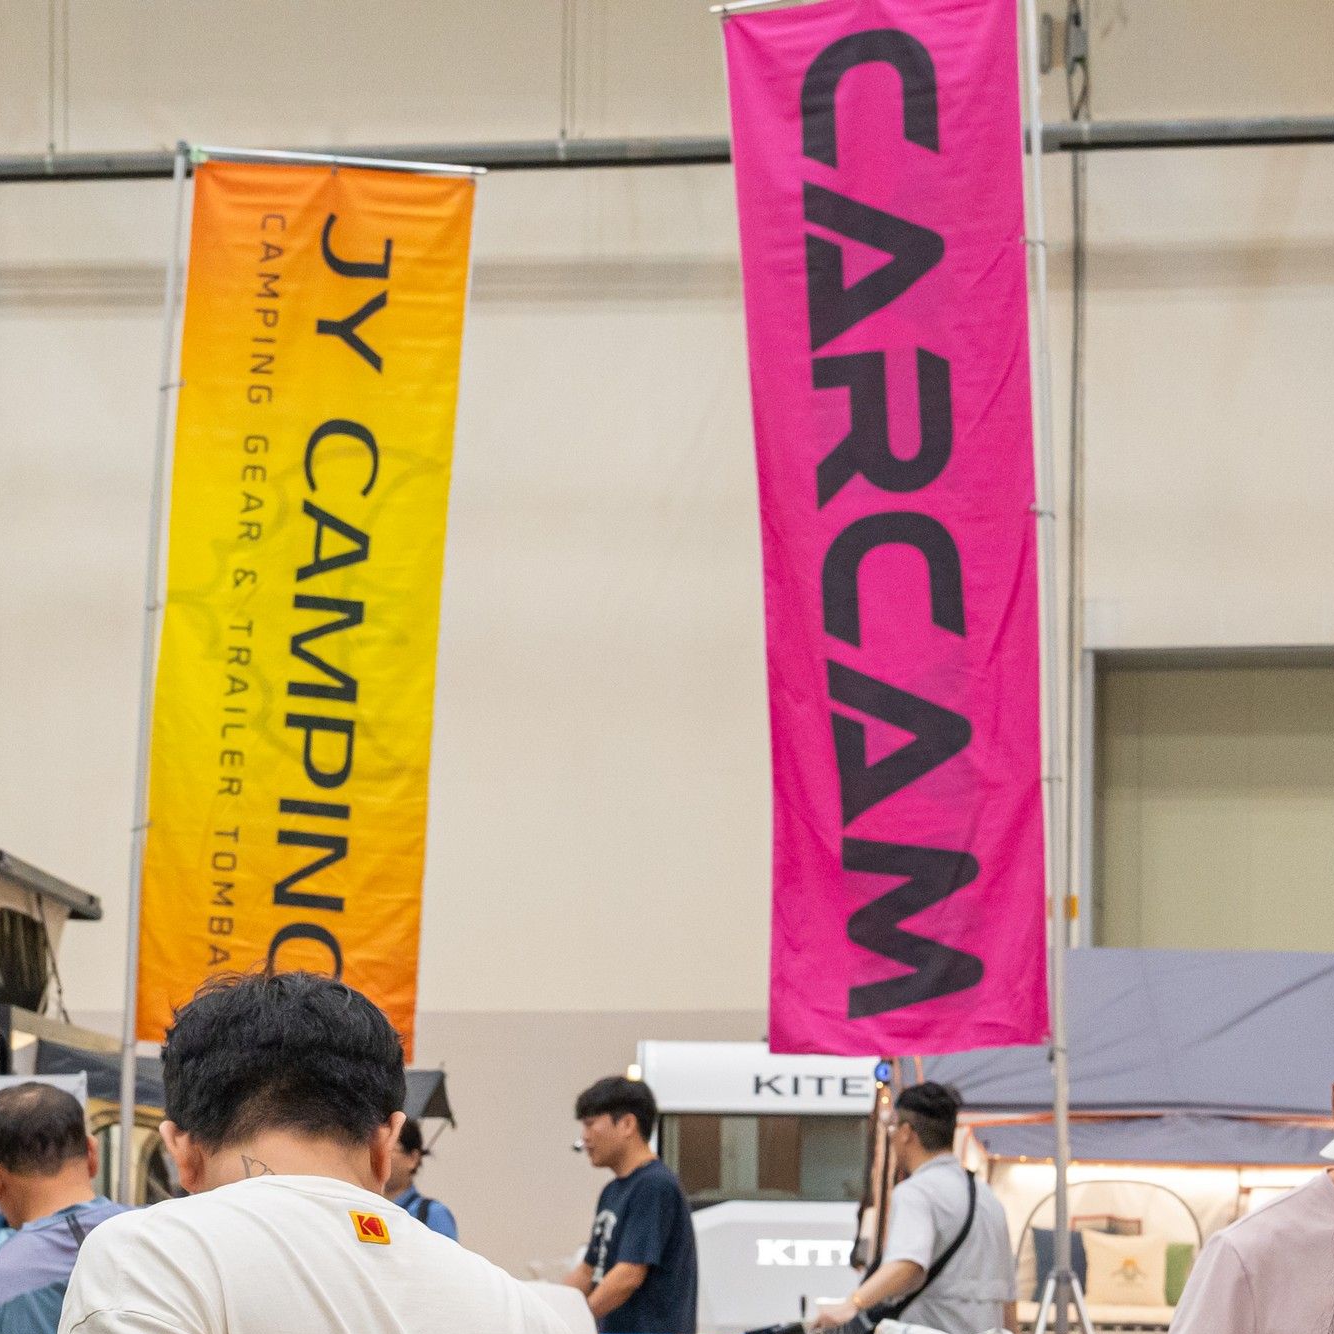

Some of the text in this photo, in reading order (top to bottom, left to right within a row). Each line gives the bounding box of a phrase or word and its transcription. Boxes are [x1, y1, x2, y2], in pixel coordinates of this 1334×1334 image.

[246, 212, 286, 406] CAMPING
[317, 211, 394, 375] JY
[238, 432, 270, 544] GEAR
[799, 27, 985, 1021] CARCAM
[232, 568, 255, 589] &
[216, 613, 254, 797] TRAILER
[752, 1074, 872, 1098] KITE
[755, 1238, 857, 1267] KIT
